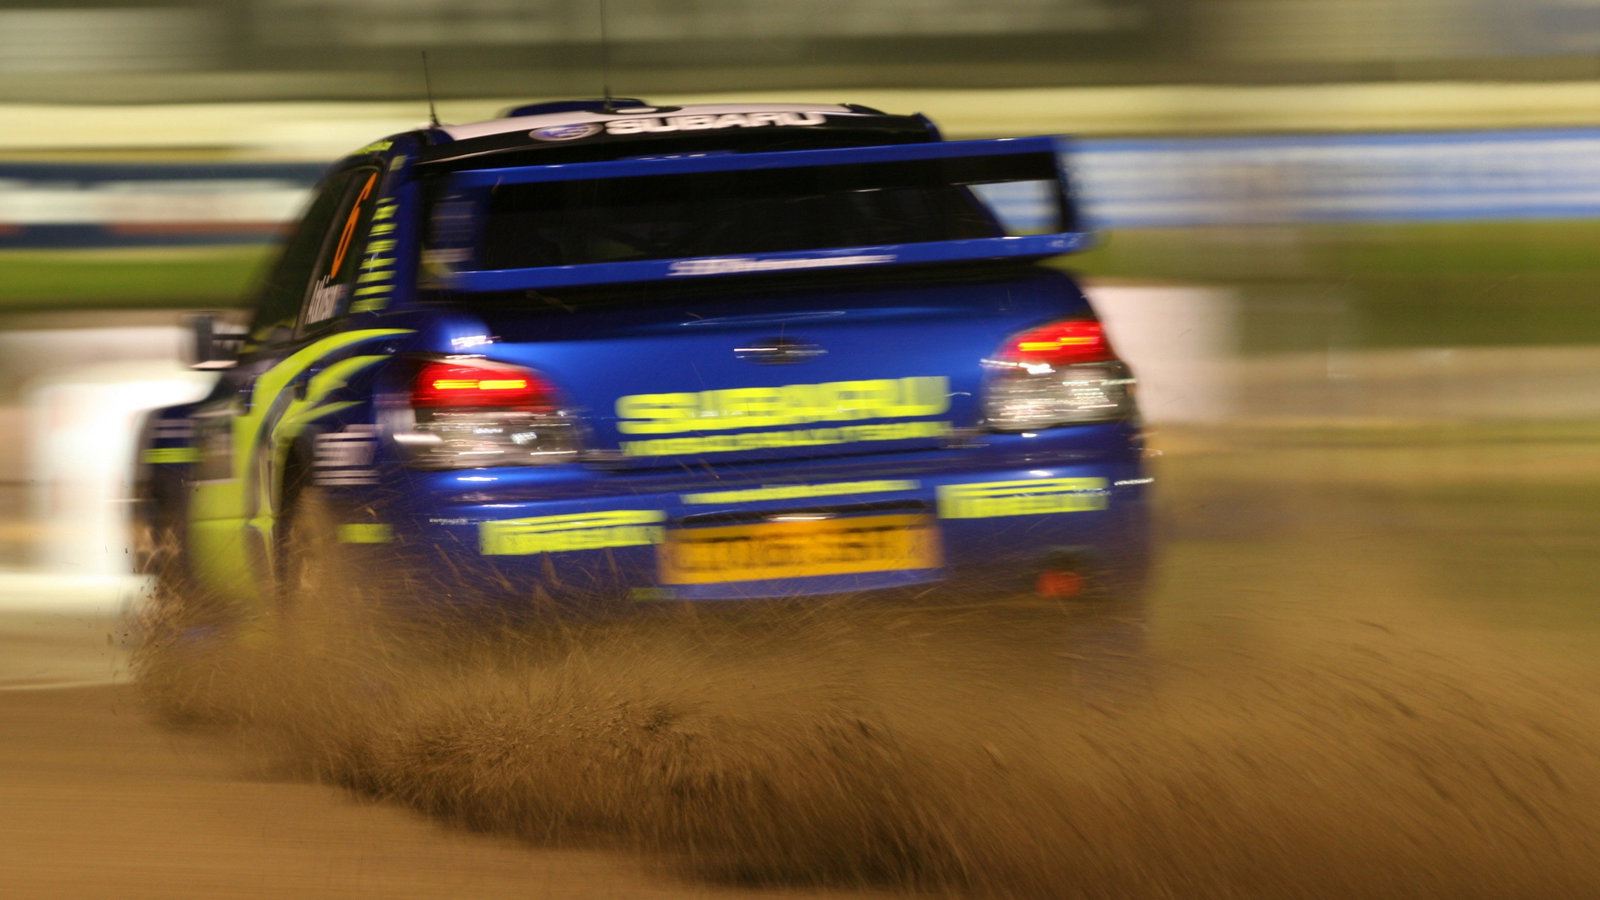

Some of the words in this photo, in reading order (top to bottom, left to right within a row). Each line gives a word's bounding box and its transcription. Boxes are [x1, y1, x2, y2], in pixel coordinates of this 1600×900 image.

[605, 112, 826, 135] SUBARU
[330, 172, 378, 280] 6
[616, 376, 949, 434] SUBARU
